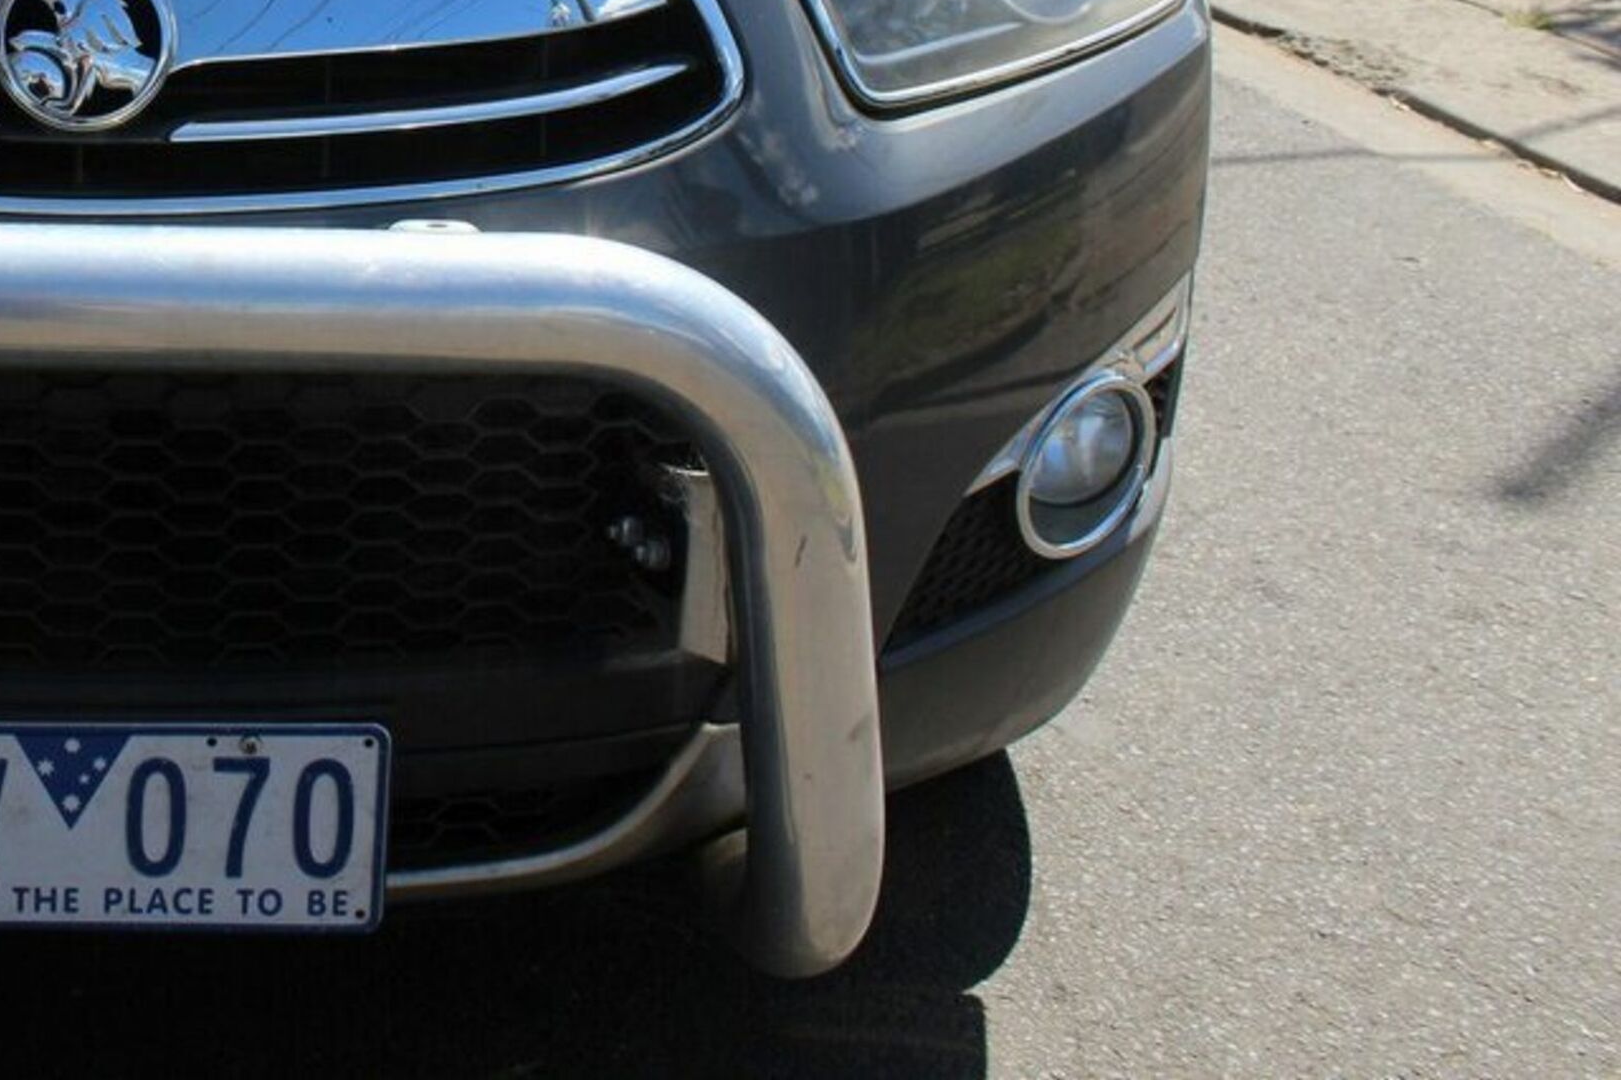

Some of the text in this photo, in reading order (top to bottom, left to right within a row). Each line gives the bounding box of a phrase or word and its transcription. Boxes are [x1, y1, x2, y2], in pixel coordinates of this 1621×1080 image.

[13, 887, 80, 914] THE
[103, 887, 214, 916] PLACE
[237, 888, 284, 916] TO
[307, 888, 349, 917] BE
